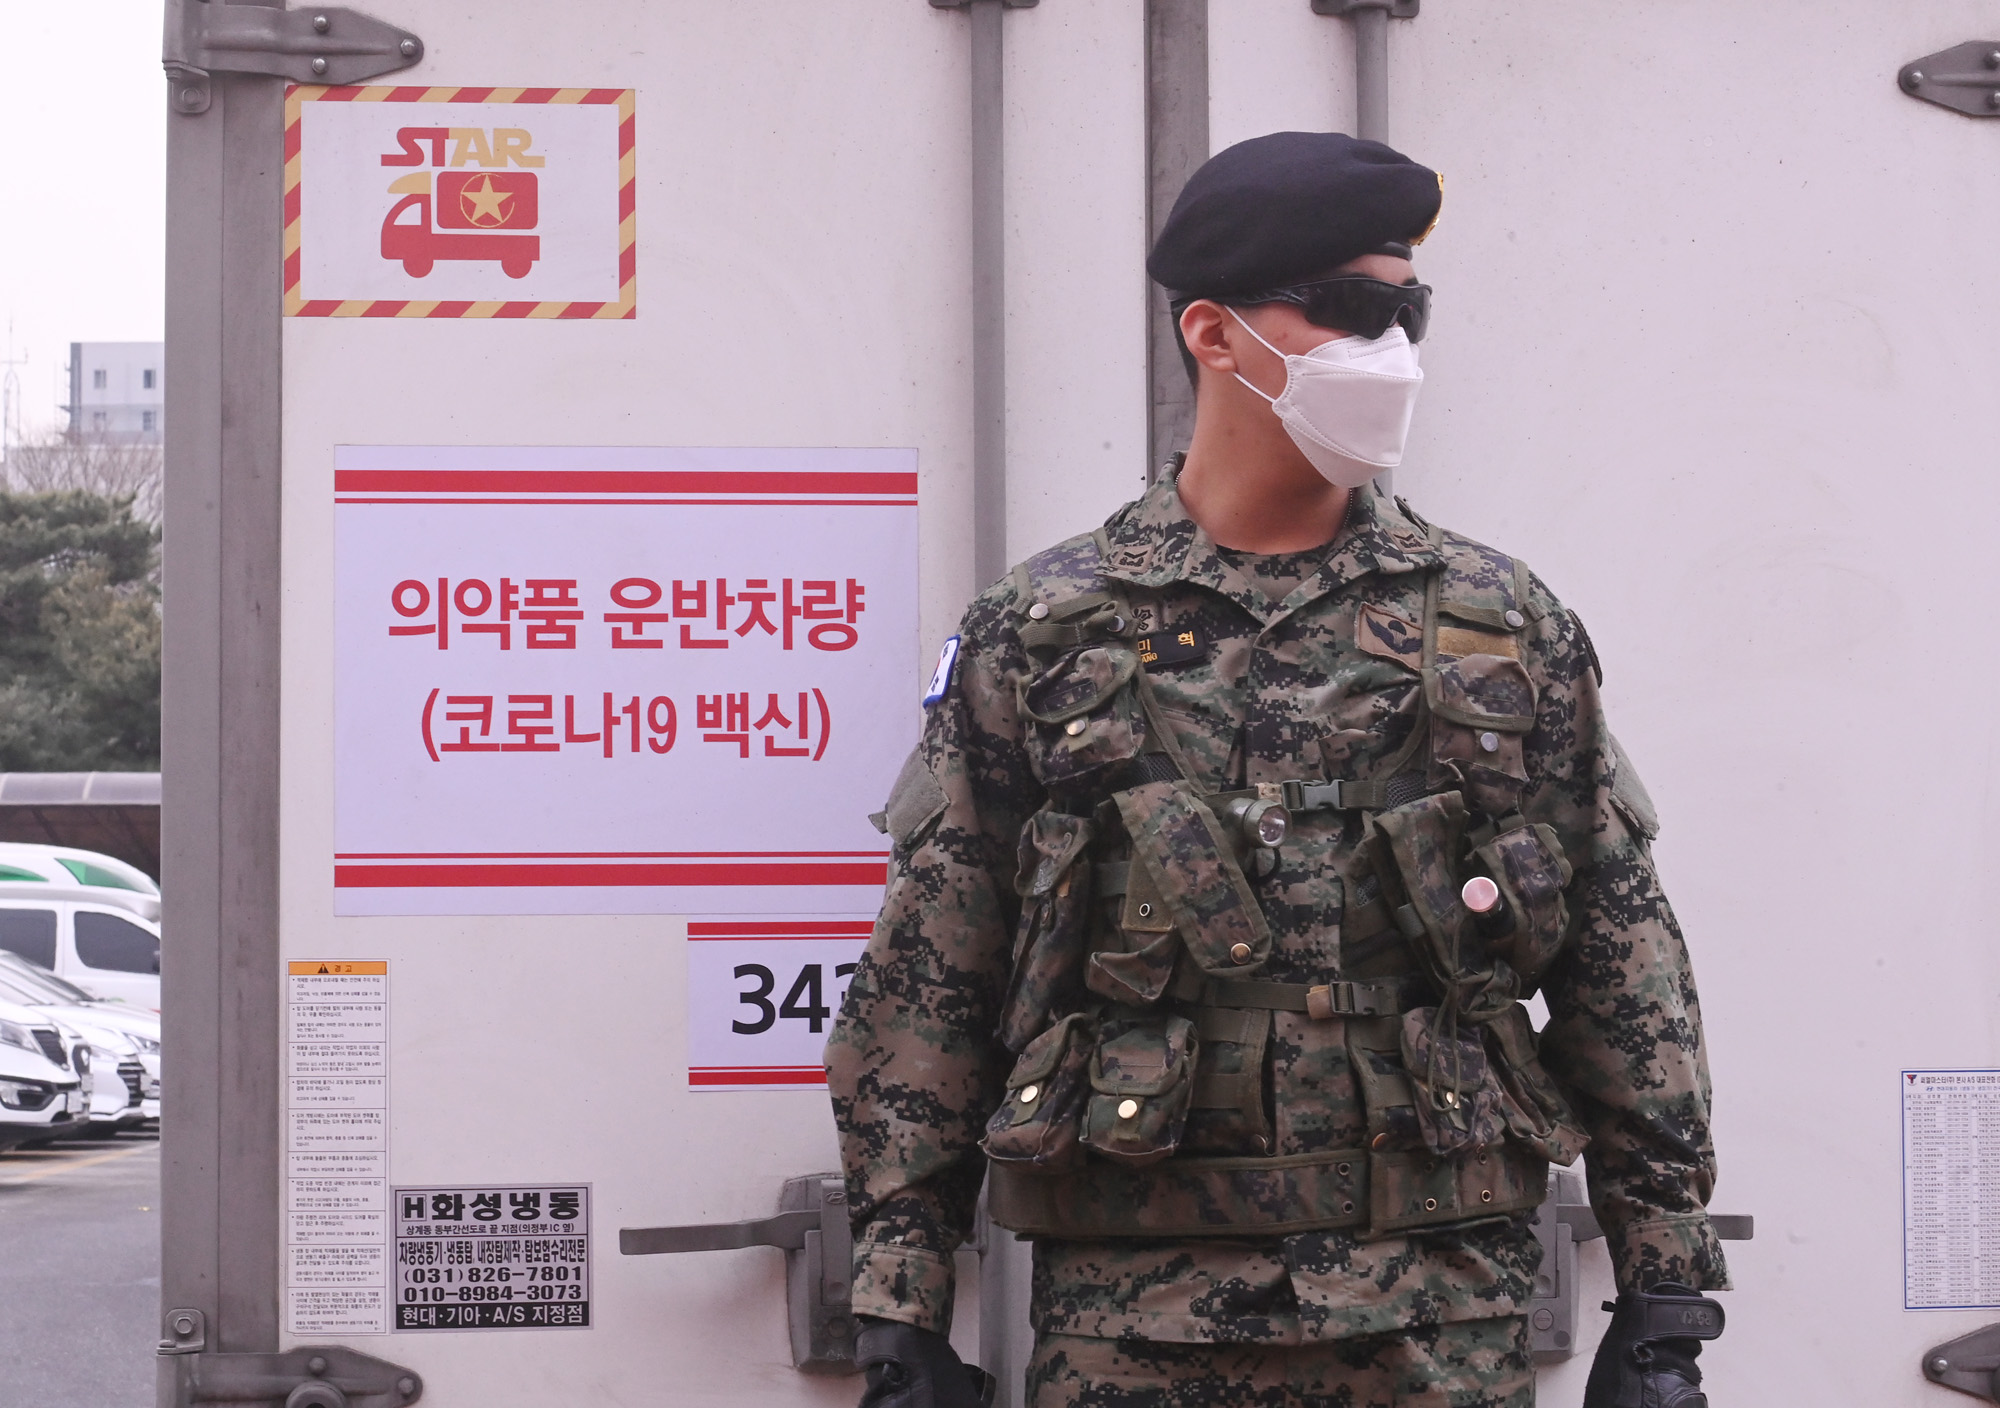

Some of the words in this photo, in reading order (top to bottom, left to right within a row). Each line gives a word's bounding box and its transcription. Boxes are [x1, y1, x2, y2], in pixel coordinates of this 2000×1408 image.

[381, 127, 545, 168] STAR
[388, 577, 584, 651] 의약품
[603, 577, 866, 652] 운반차량
[421, 687, 678, 762] (코로나19
[697, 687, 831, 762] 백신)
[431, 1192, 580, 1221] 화성냉동
[406, 1225, 432, 1235] 상계동
[434, 1225, 487, 1235] 동부간선도로
[549, 1223, 560, 1233] IC
[404, 1265, 581, 1283] (031)826-7801
[404, 1284, 582, 1302] 010-8984-3073
[532, 1304, 583, 1324] 지정점
